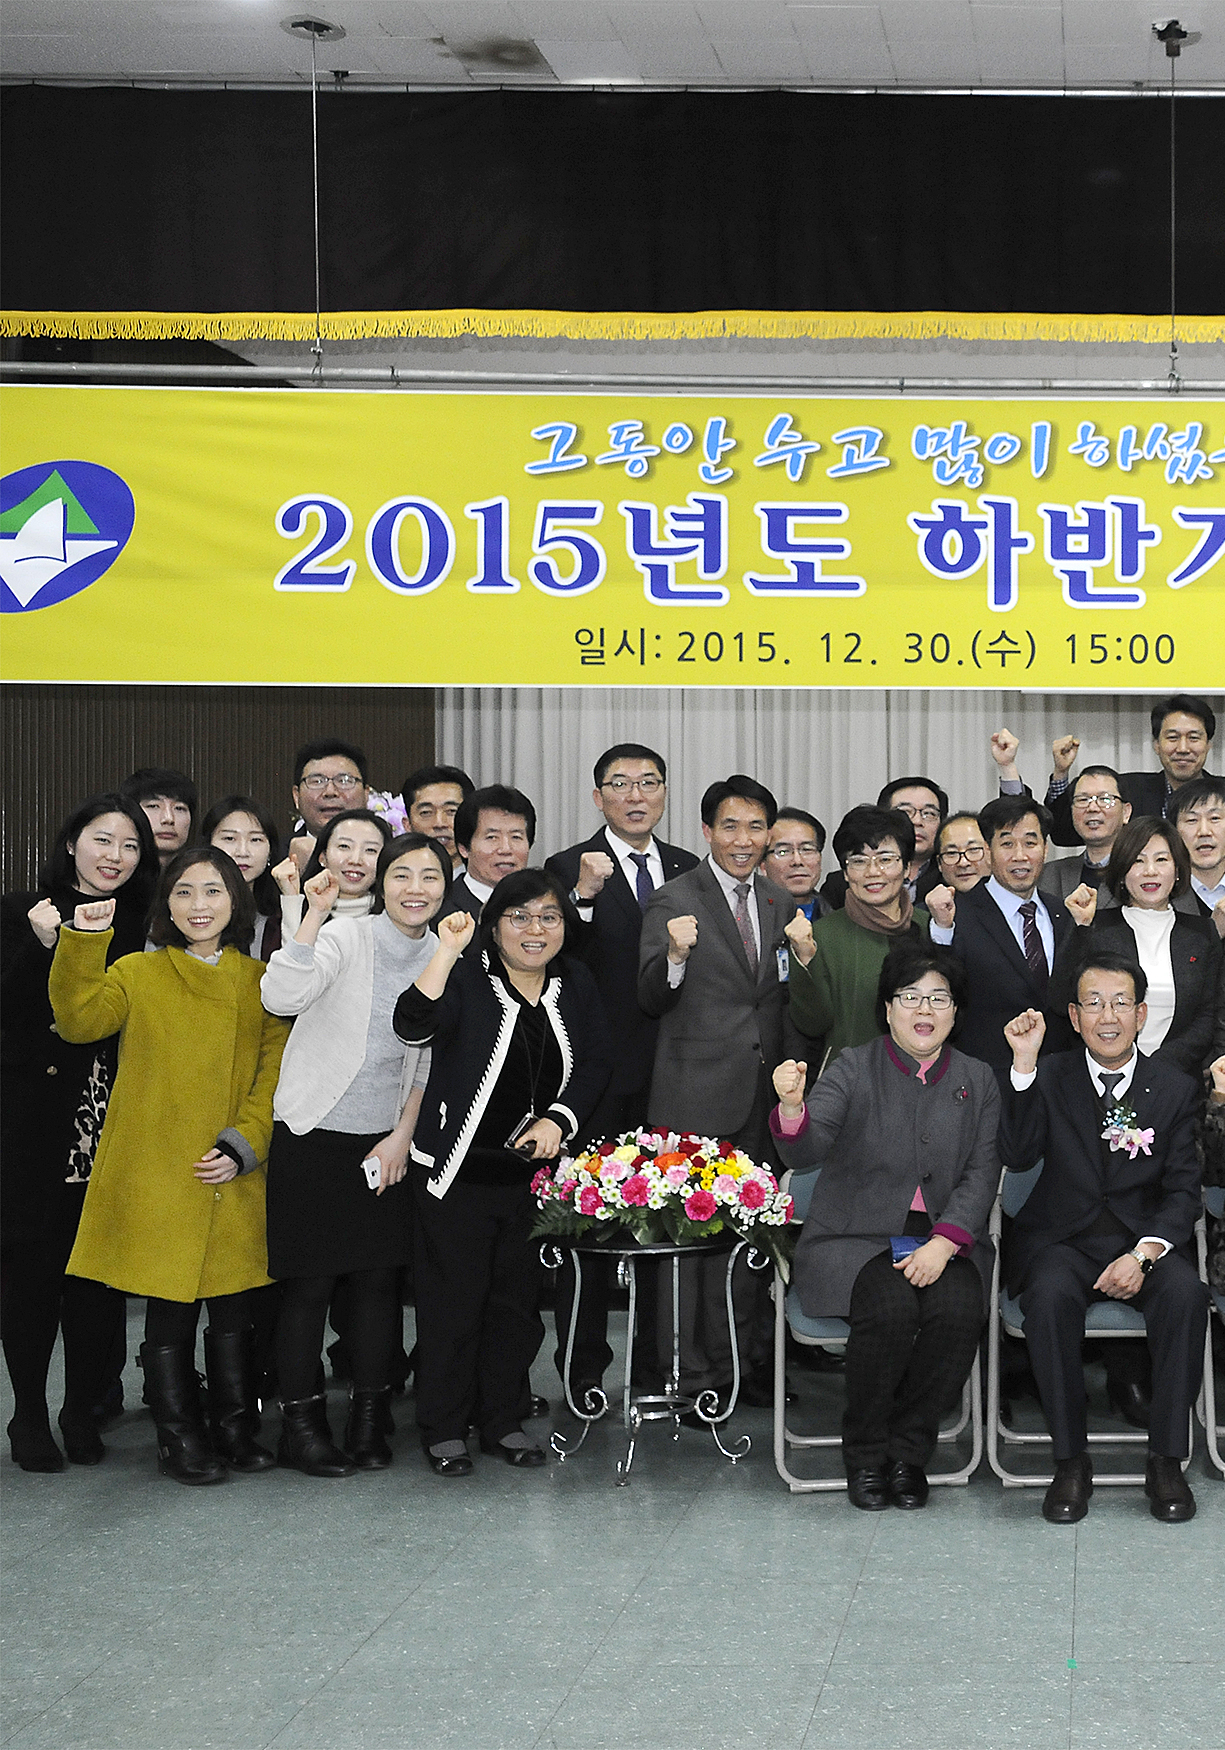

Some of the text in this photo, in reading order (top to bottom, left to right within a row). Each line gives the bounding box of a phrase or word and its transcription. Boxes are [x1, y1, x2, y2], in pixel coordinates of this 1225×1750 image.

[525, 417, 735, 483] 그동안
[754, 414, 889, 480] 수고
[912, 421, 1050, 488] 많이
[276, 494, 864, 604] 2015년도
[574, 627, 1175, 670] 일시: 2015. 12. 30.(수) 15:00
